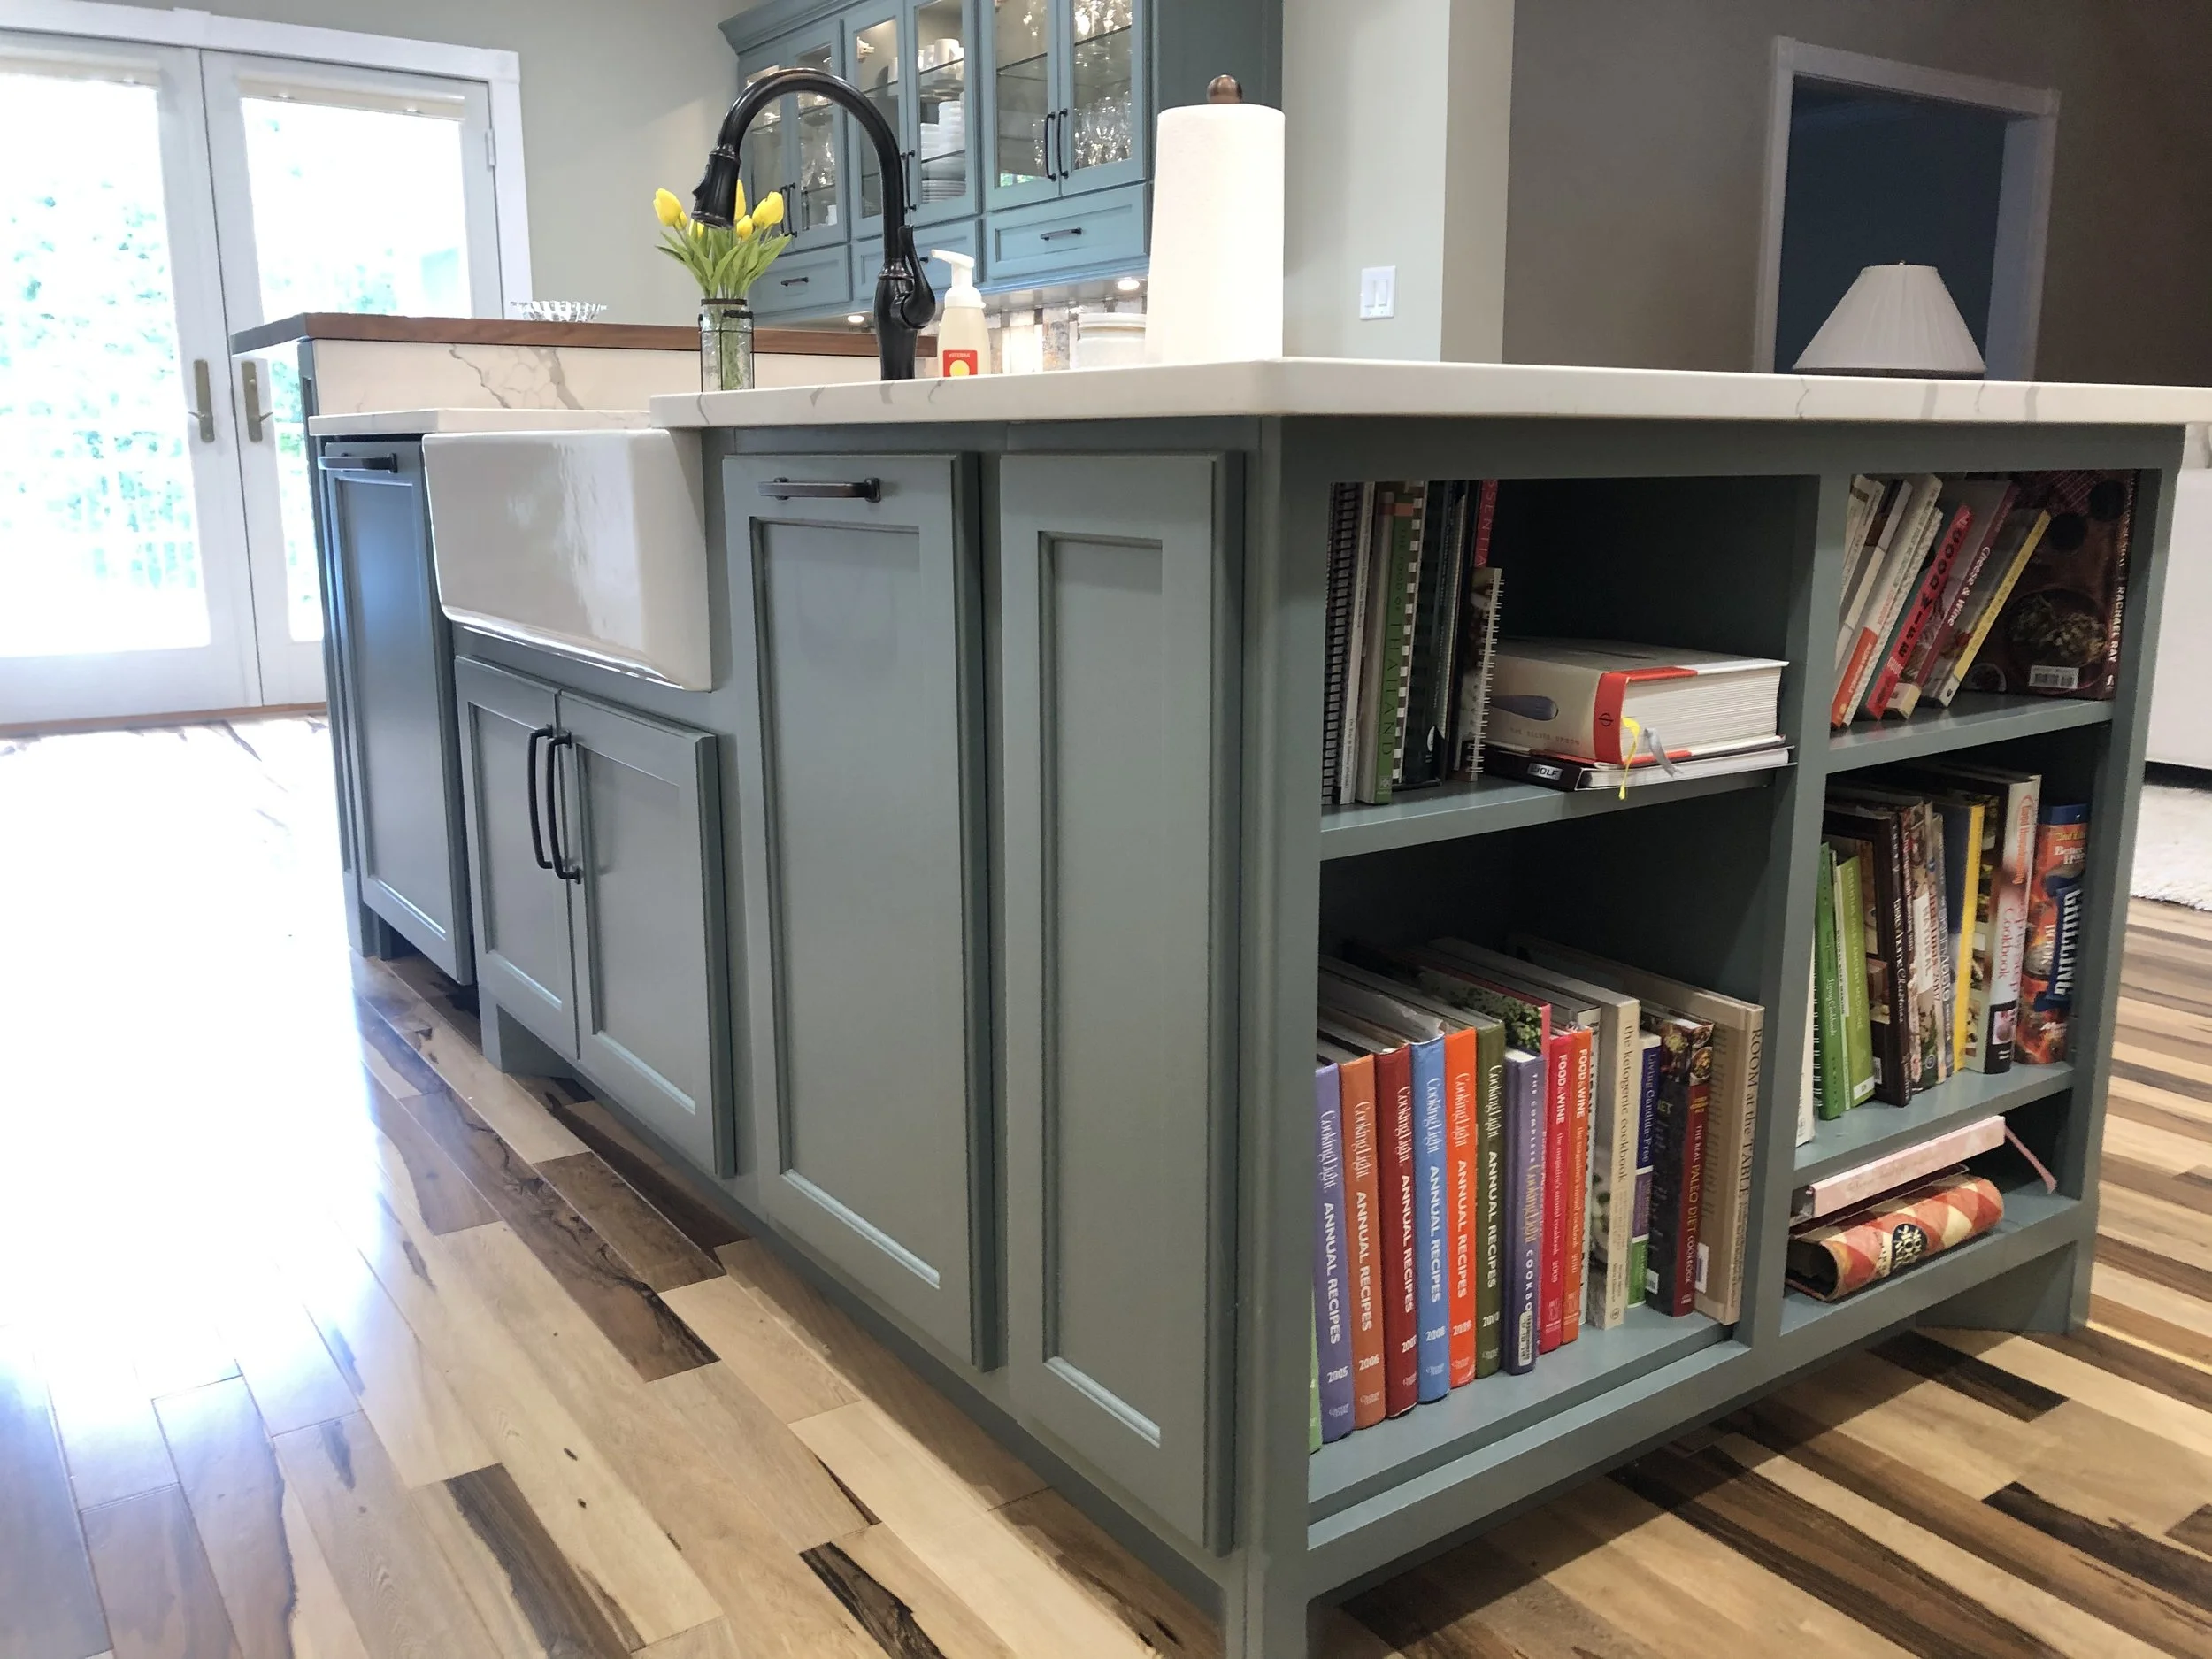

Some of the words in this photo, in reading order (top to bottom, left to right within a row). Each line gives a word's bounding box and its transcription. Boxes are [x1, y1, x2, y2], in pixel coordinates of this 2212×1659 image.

[1477, 479, 1497, 566] SSENTIA
[1961, 586, 1970, 596] &
[1967, 546, 1991, 586] Cheese
[1947, 599, 1966, 626] Wine
[2111, 586, 2126, 637] RACHAEL
[2108, 641, 2119, 663] RAY
[1381, 622, 1402, 756] THAILAND
[1531, 764, 1560, 777] WOLF
[1847, 866, 1856, 917] ESSENTIAL
[1855, 987, 1863, 1031] MEDICINE
[1928, 880, 1939, 966] Christmas
[1999, 907, 2015, 979] Cookbook
[2041, 924, 2055, 965] BOOK
[2054, 888, 2083, 995] GRILLING
[1897, 968, 1907, 1023] Christmas
[1624, 1025, 1635, 1048] the
[1747, 1027, 1763, 1088] ROOM
[1620, 1048, 1633, 1115] ketogenic
[1644, 1053, 1657, 1089] Living
[1741, 1110, 1756, 1137] the
[1745, 1092, 1755, 1107] at
[1529, 1100, 1538, 1164] COMPLETE
[1555, 1132, 1564, 1145] the
[1617, 1118, 1631, 1183] cookbook
[1693, 1142, 1701, 1164] REAL
[1694, 1125, 1703, 1141] THE
[1457, 1159, 1468, 1233] ANNUAL
[1487, 1150, 1499, 1223] ANNUAL
[1554, 1147, 1563, 1190] magazine's
[1688, 1164, 1701, 1202] PALEO
[1738, 1141, 1754, 1196] TABLE
[1401, 1174, 1414, 1248] ANNUAL
[1430, 1165, 1441, 1238] ANNUAL
[1573, 1185, 1582, 1211] annual
[1686, 1206, 1698, 1235] DIET
[1323, 1202, 1339, 1276] ANNUAL
[1356, 1191, 1371, 1264] ANNUAL
[1571, 1211, 1580, 1248] cookbook
[1402, 1247, 1415, 1314] RECIPES
[1430, 1239, 1441, 1303] RECIPES
[1456, 1233, 1468, 1299] RECIPES
[1487, 1224, 1499, 1289] RECIPES
[1525, 1249, 1535, 1311] COOKBO
[1685, 1234, 1695, 1285] COOKBOOK
[1326, 1278, 1341, 1345] RECIPES
[1358, 1266, 1372, 1332] RECIPES
[1425, 1325, 1446, 1342] 2008
[1358, 1353, 1380, 1371] 2006
